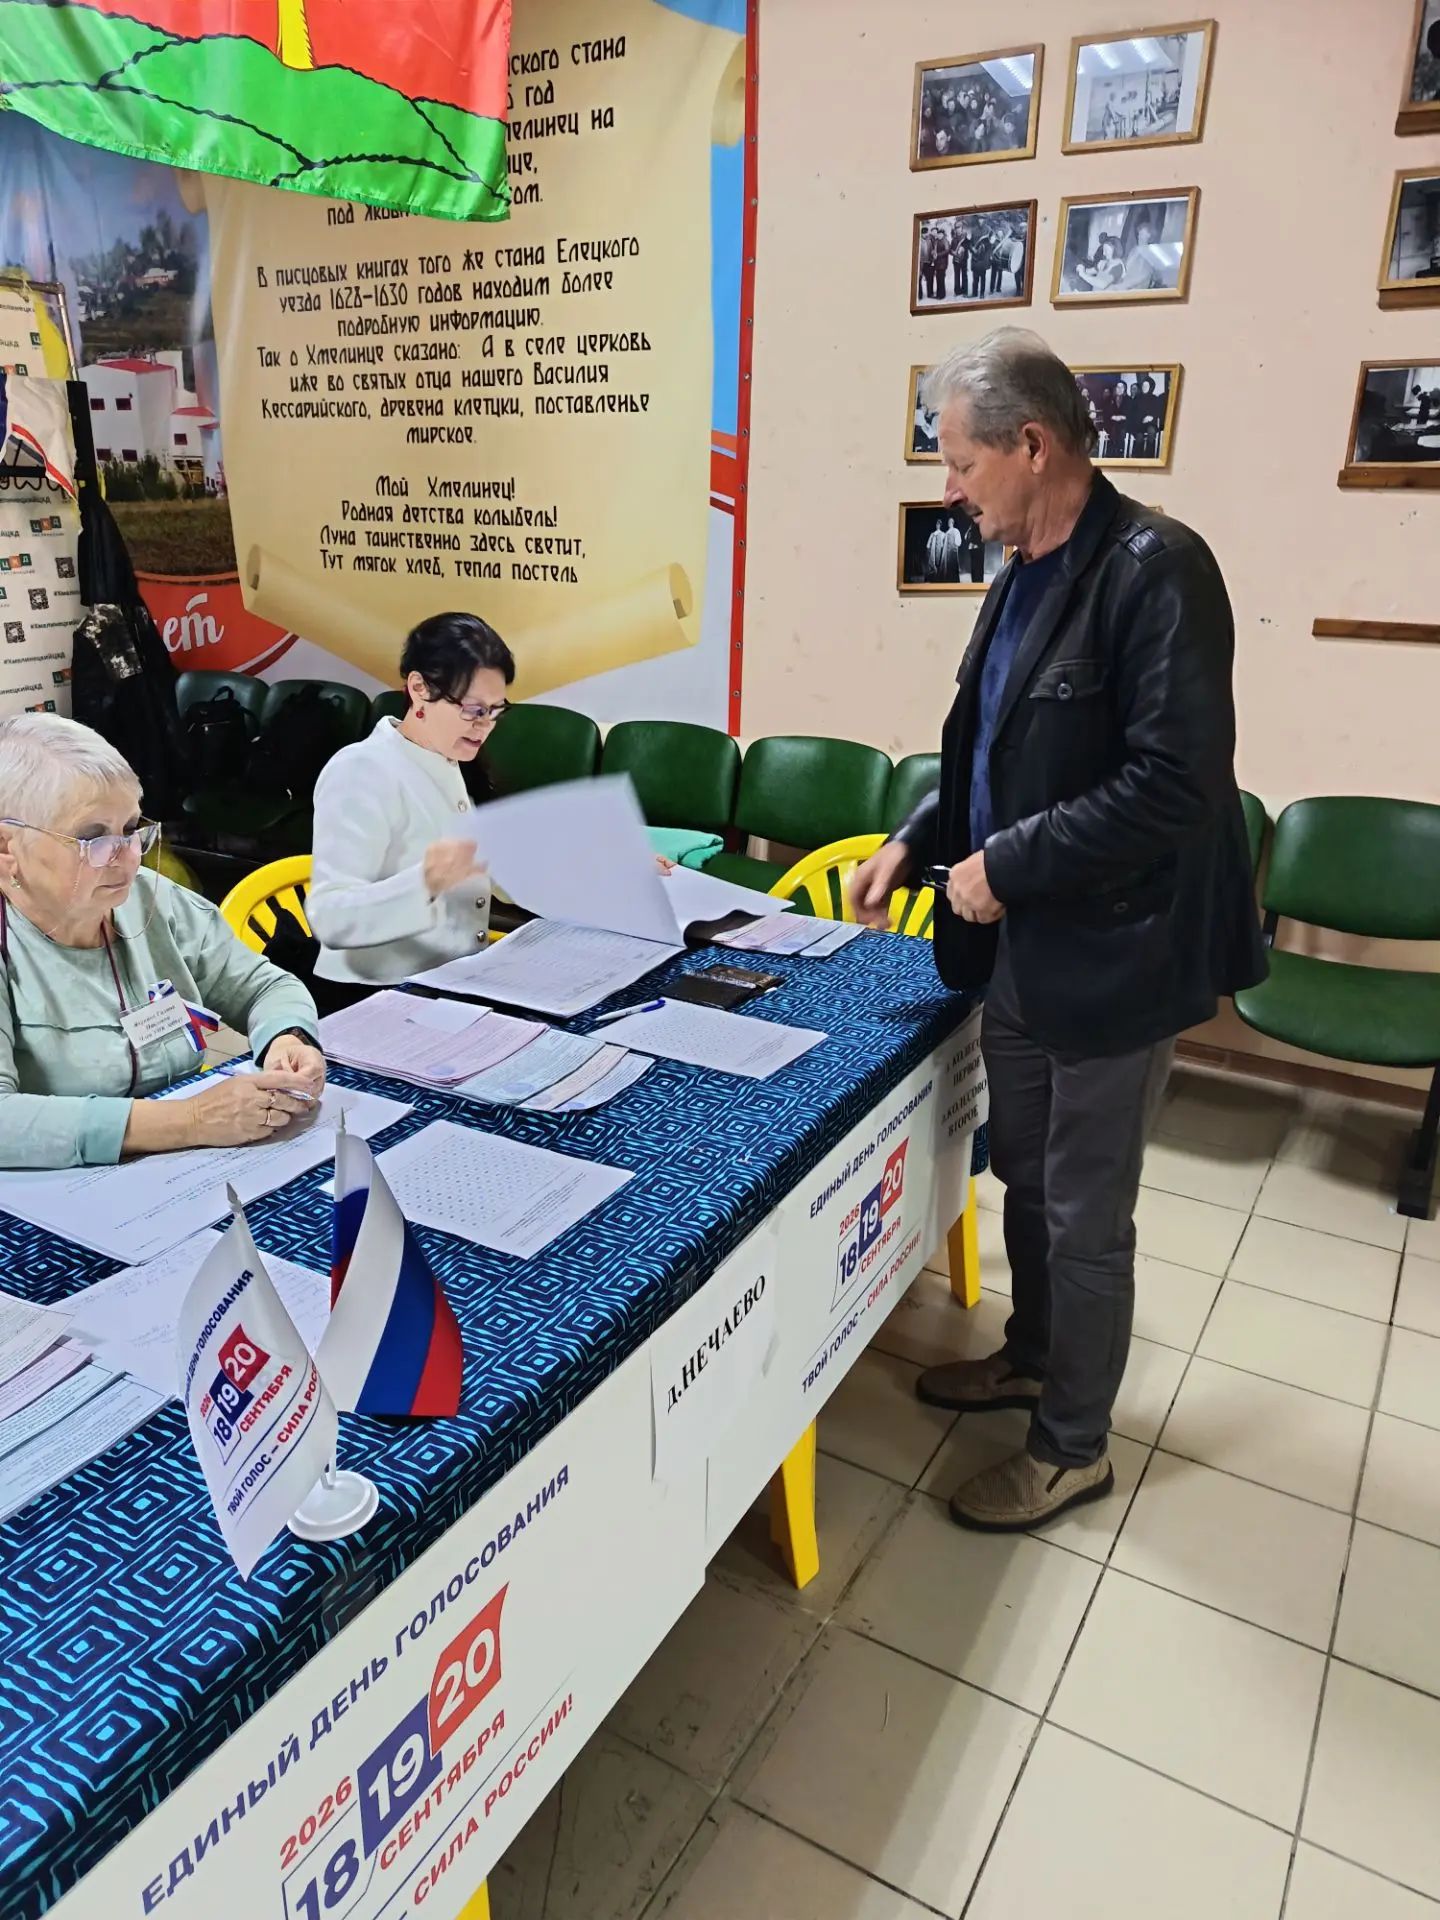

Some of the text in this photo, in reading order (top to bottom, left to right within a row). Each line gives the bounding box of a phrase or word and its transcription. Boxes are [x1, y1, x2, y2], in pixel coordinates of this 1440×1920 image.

[508, 35, 626, 76] ского стана
[526, 79, 554, 107] год
[591, 107, 614, 130] на
[328, 202, 354, 226] под
[257, 237, 640, 287] В писцовых книгах того же стана Елецкого
[280, 292, 321, 313] уезда
[418, 282, 462, 303] годов
[473, 276, 550, 300] находим
[562, 272, 613, 293] более
[338, 308, 544, 336] подробную информацию.
[257, 332, 651, 367] Так о Хмелинце сказано: А в селе церковь
[290, 362, 609, 392] иже во святых отца нашего Василия
[262, 398, 371, 420] Кессарийского,
[381, 397, 443, 417] древена
[535, 394, 650, 414] поставленье
[376, 475, 516, 501] Мой Хмелинец!
[341, 500, 557, 527] Родная детства колыбель!
[320, 525, 586, 559] Луна таинственно здесь светит,
[320, 549, 578, 583] Тут мягок хлеб, тепла постель
[810, 1080, 933, 1219] ЕДИНЫЙ ДЕНЬ ГОЛОСОВАНИЯ
[839, 1203, 860, 1236] 2026
[840, 1158, 902, 1285] 18 19 20
[861, 1215, 901, 1273] СЕНТЯБРЯ
[196, 1269, 254, 1355] ГОЛОСОВАНИЯ
[802, 1349, 828, 1393] ТВОЙ
[829, 1312, 858, 1359] ГОЛОС
[867, 1274, 888, 1309] СИЛА
[213, 1343, 256, 1446] 18 19 20
[239, 1365, 292, 1433] СЕНТЯБРЯ
[227, 1488, 245, 1516] ТВОЙ
[242, 1454, 272, 1493] ГОЛОС
[277, 1403, 310, 1444] СИЛА
[142, 1464, 570, 1916] ЕДИНЫЙ ДЕНЬ ГОЛОСОВАНИЯ
[296, 1628, 496, 1920] 18 19 20
[380, 1709, 505, 1870] СЕНТЯБРЯ
[413, 1693, 574, 1905] СИЛА РОССИИ!
[280, 1776, 352, 1870] 2026
